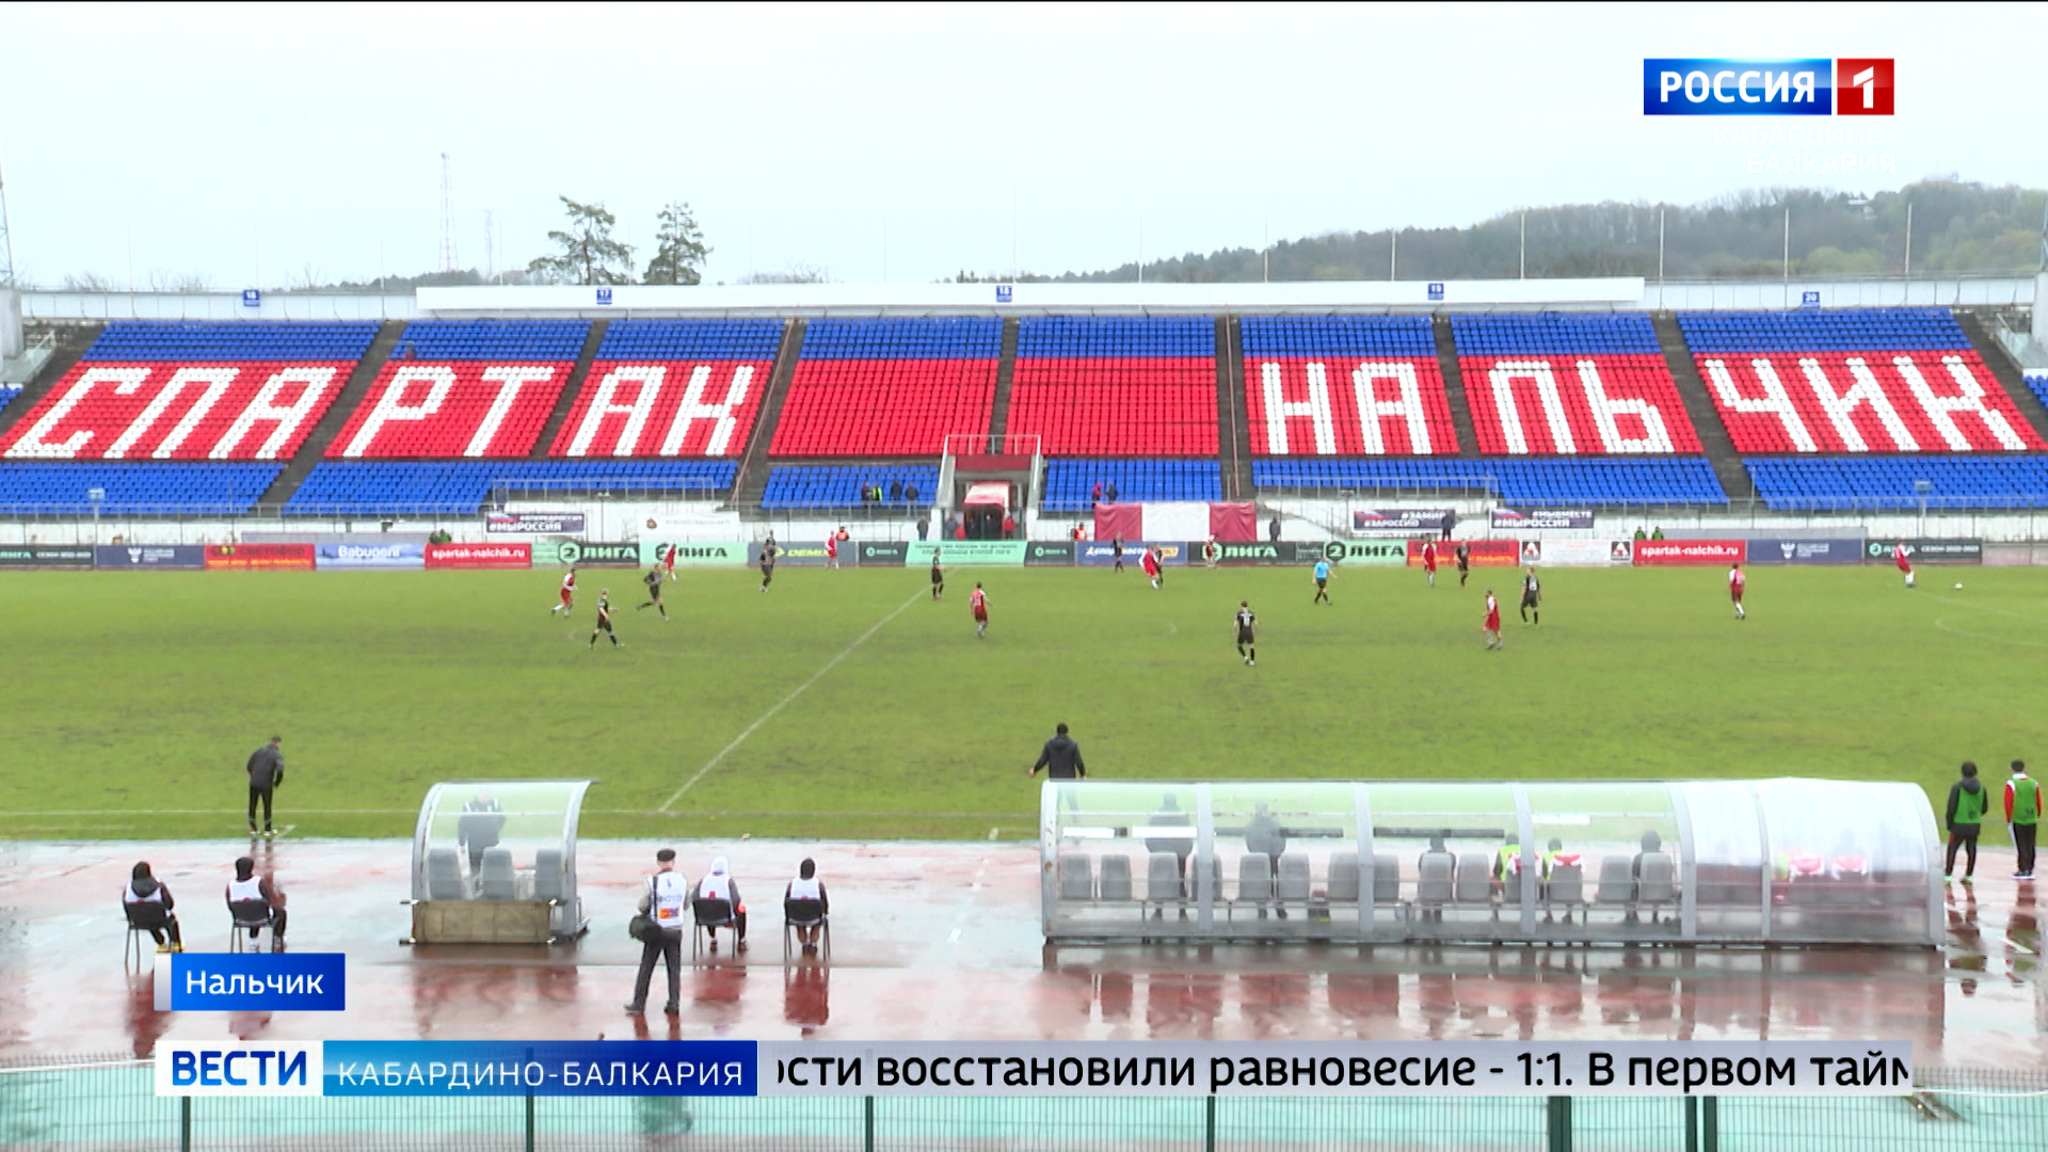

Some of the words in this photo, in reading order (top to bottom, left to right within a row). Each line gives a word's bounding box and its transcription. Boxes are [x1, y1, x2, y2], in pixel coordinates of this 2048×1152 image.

[432, 548, 525, 560] spartak-nalchik.ru
[583, 547, 638, 559] ЛИГА
[678, 547, 728, 557] ЛИГА
[1225, 546, 1278, 557] ЛИГА
[1350, 545, 1405, 557] ЛИГА
[1641, 546, 1739, 558] spartak-nalchik.ru
